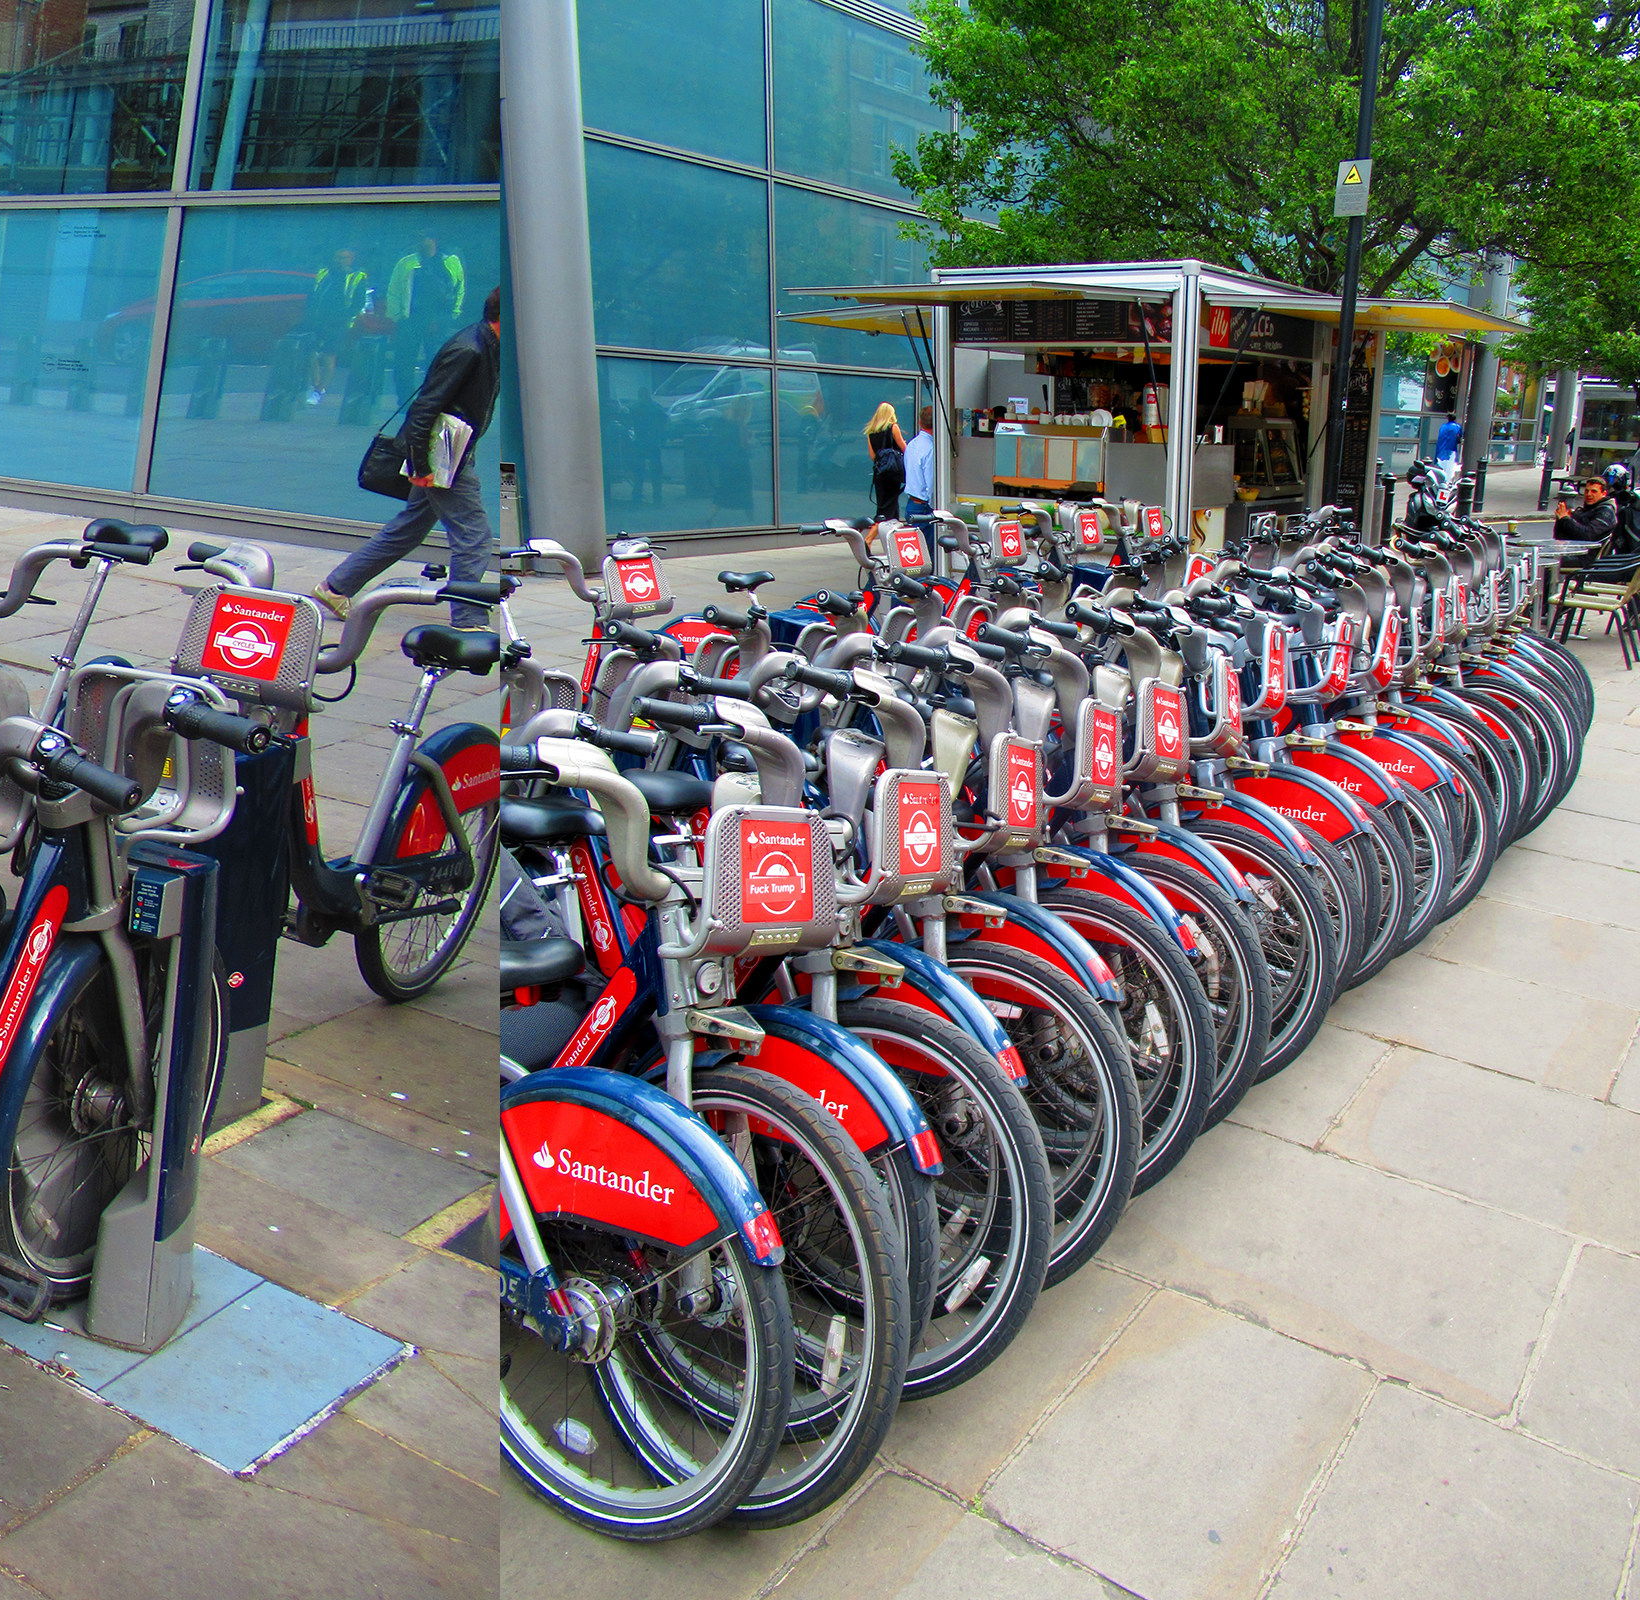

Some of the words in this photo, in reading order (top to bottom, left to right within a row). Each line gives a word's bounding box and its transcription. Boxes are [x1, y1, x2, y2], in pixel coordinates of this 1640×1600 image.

[1439, 491, 1447, 500] L
[625, 562, 650, 571] Santander
[233, 604, 286, 623] Santander
[232, 639, 255, 650] CYCLES
[758, 831, 806, 847] Santander
[578, 864, 599, 917] Sntander
[750, 884, 770, 895] Fuck
[771, 882, 796, 896] Trump
[557, 1148, 675, 1206] Santander
